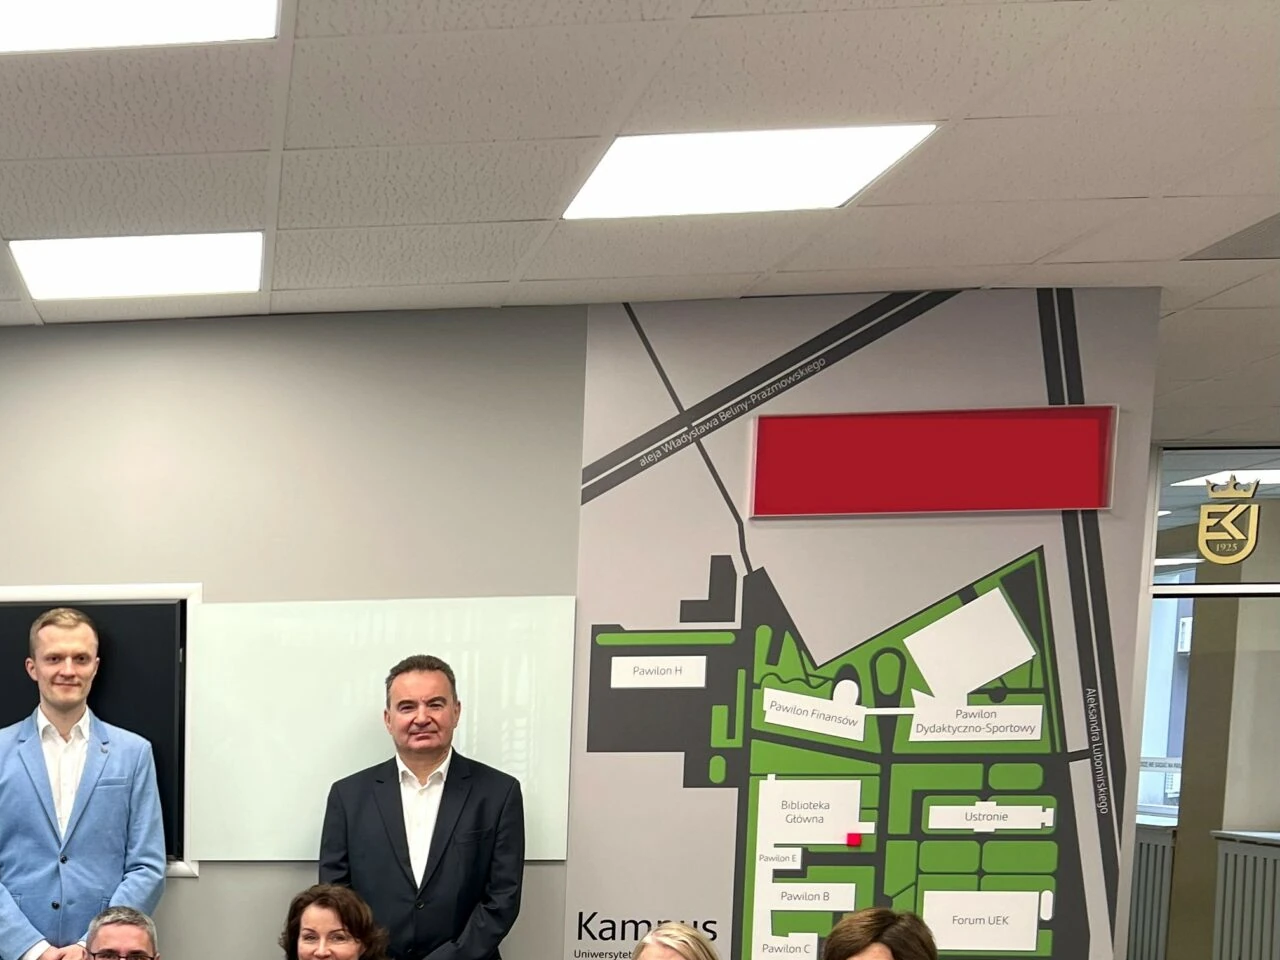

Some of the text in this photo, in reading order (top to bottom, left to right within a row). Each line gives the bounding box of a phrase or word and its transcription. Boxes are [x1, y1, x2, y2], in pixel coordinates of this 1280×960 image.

[639, 356, 827, 467] aleja Władysława Beliny-Prażmowskiego
[1216, 543, 1238, 552] 1925
[632, 665, 683, 677] Pawilon H
[769, 700, 859, 728] Pawilon Finansów
[955, 709, 997, 720] Pawilon
[915, 722, 1037, 736] Dydaktyczno-Sportowy
[1086, 688, 1108, 814] Aleksandra Lubomirskiego
[781, 800, 830, 810] Biblioteka
[785, 812, 824, 824] Główna
[964, 811, 1009, 823] Ustronie
[758, 853, 797, 863] Pawilon E
[781, 891, 830, 902] Pawilon B
[577, 911, 718, 941] Kams
[952, 915, 1009, 926] Forum UEK
[762, 943, 811, 954] Pawilon C
[574, 949, 632, 960] Uniwersytet
